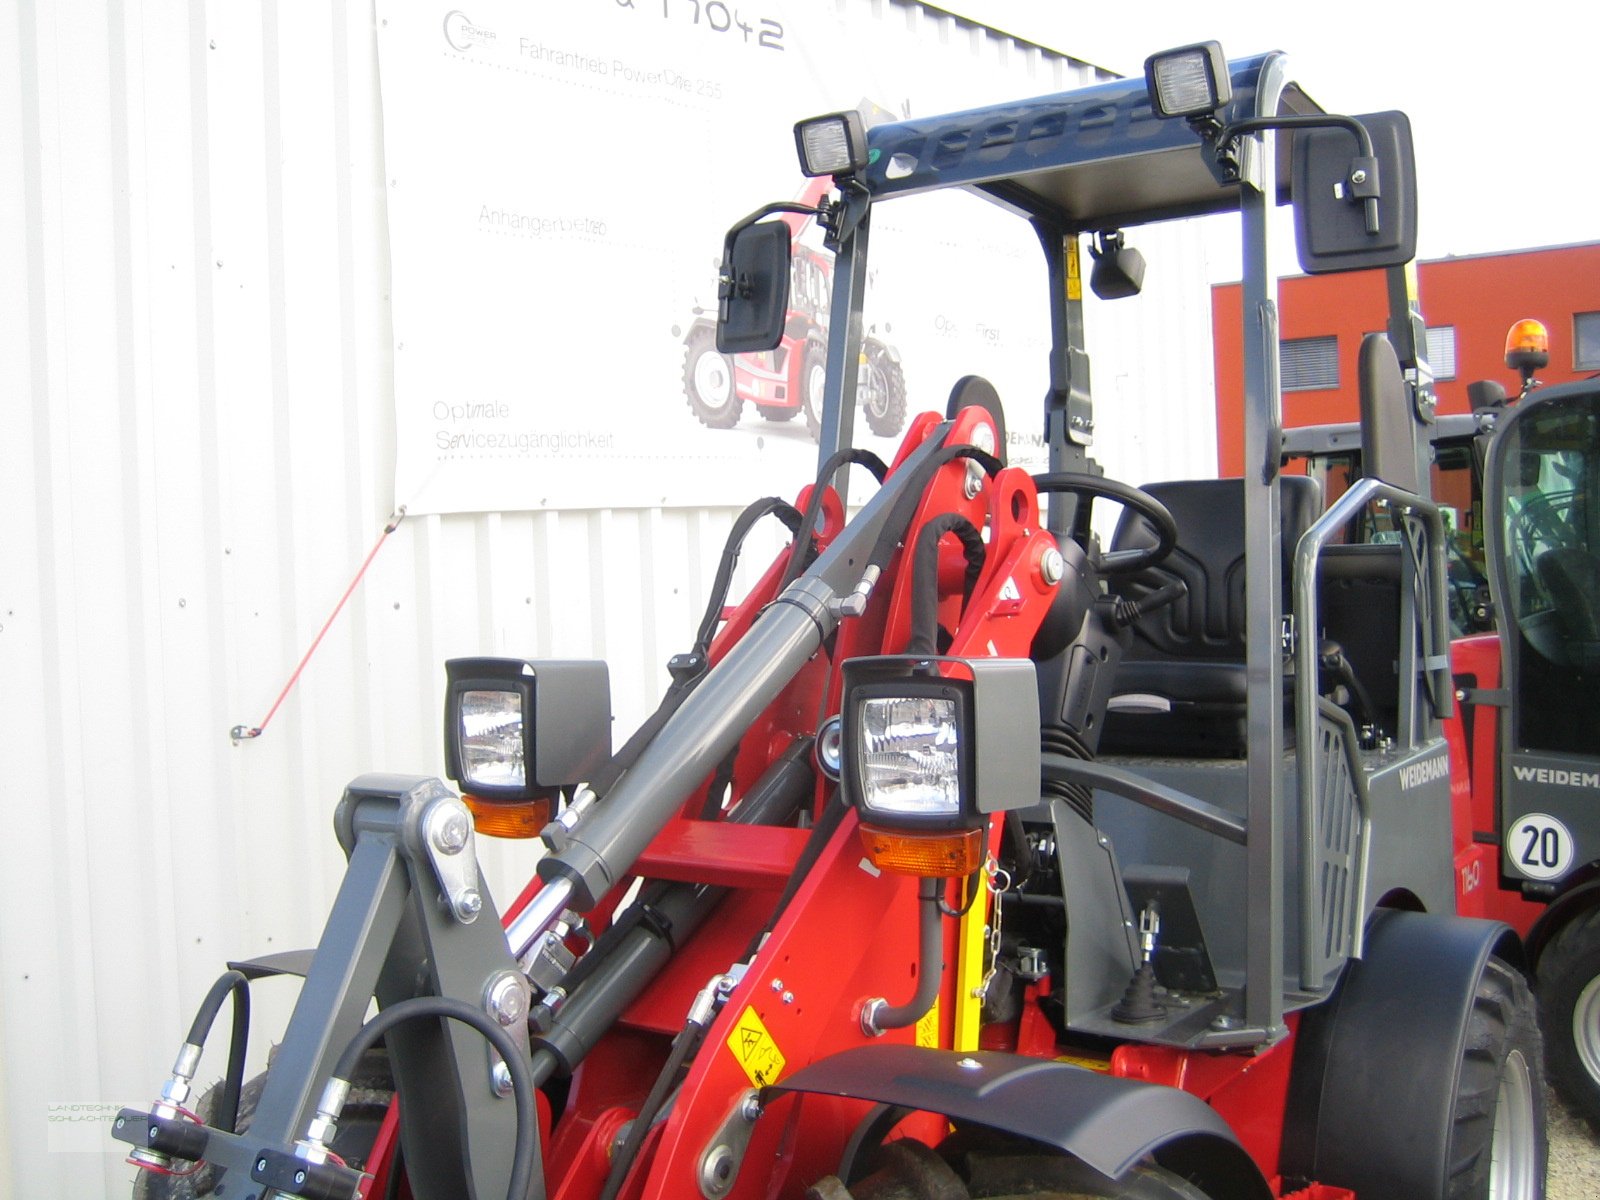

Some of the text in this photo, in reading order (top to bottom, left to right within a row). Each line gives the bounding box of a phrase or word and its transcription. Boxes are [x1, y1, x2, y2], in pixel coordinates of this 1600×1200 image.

[461, 25, 496, 40] POWER
[519, 37, 608, 76] Fahrantrieb
[696, 78, 722, 100] 255
[433, 400, 509, 424] Optimale
[435, 430, 615, 453] Servicezugänglichkeit
[1400, 754, 1449, 791] WEIDEMANN
[1513, 765, 1600, 789] WEIDEM
[1521, 824, 1559, 868] 20
